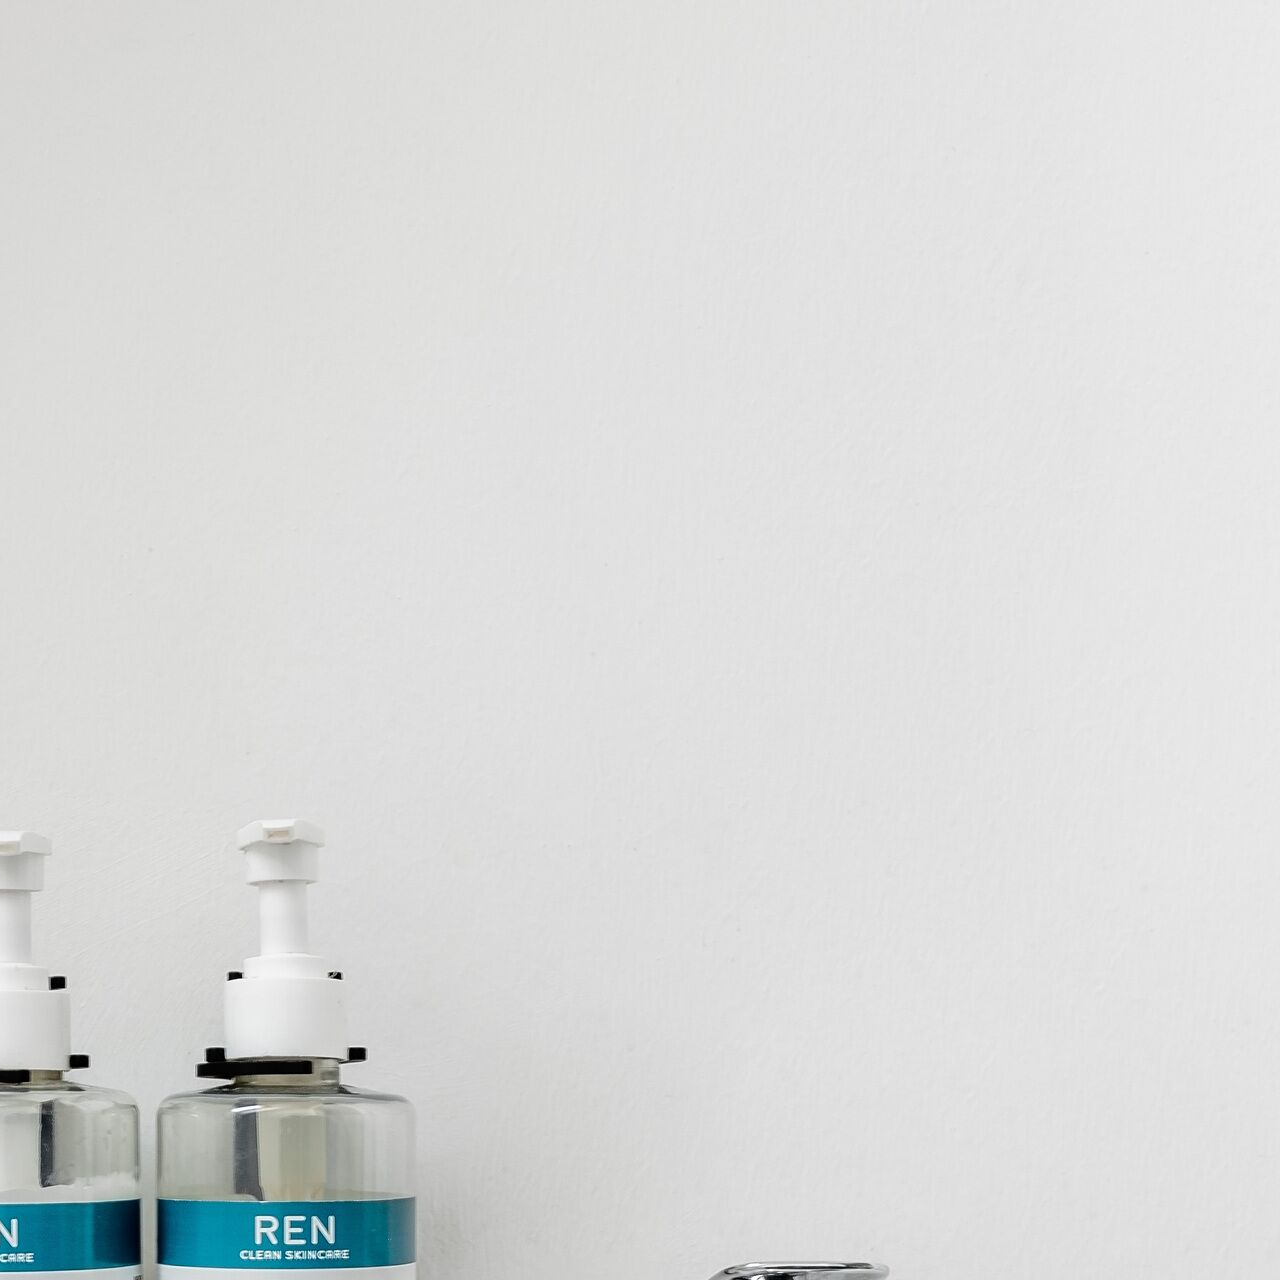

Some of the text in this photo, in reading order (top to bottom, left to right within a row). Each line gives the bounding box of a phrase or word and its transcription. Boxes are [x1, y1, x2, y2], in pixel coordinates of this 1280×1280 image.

[255, 1216, 335, 1244] REN
[240, 1250, 349, 1259] CLEAN SKINCARE
